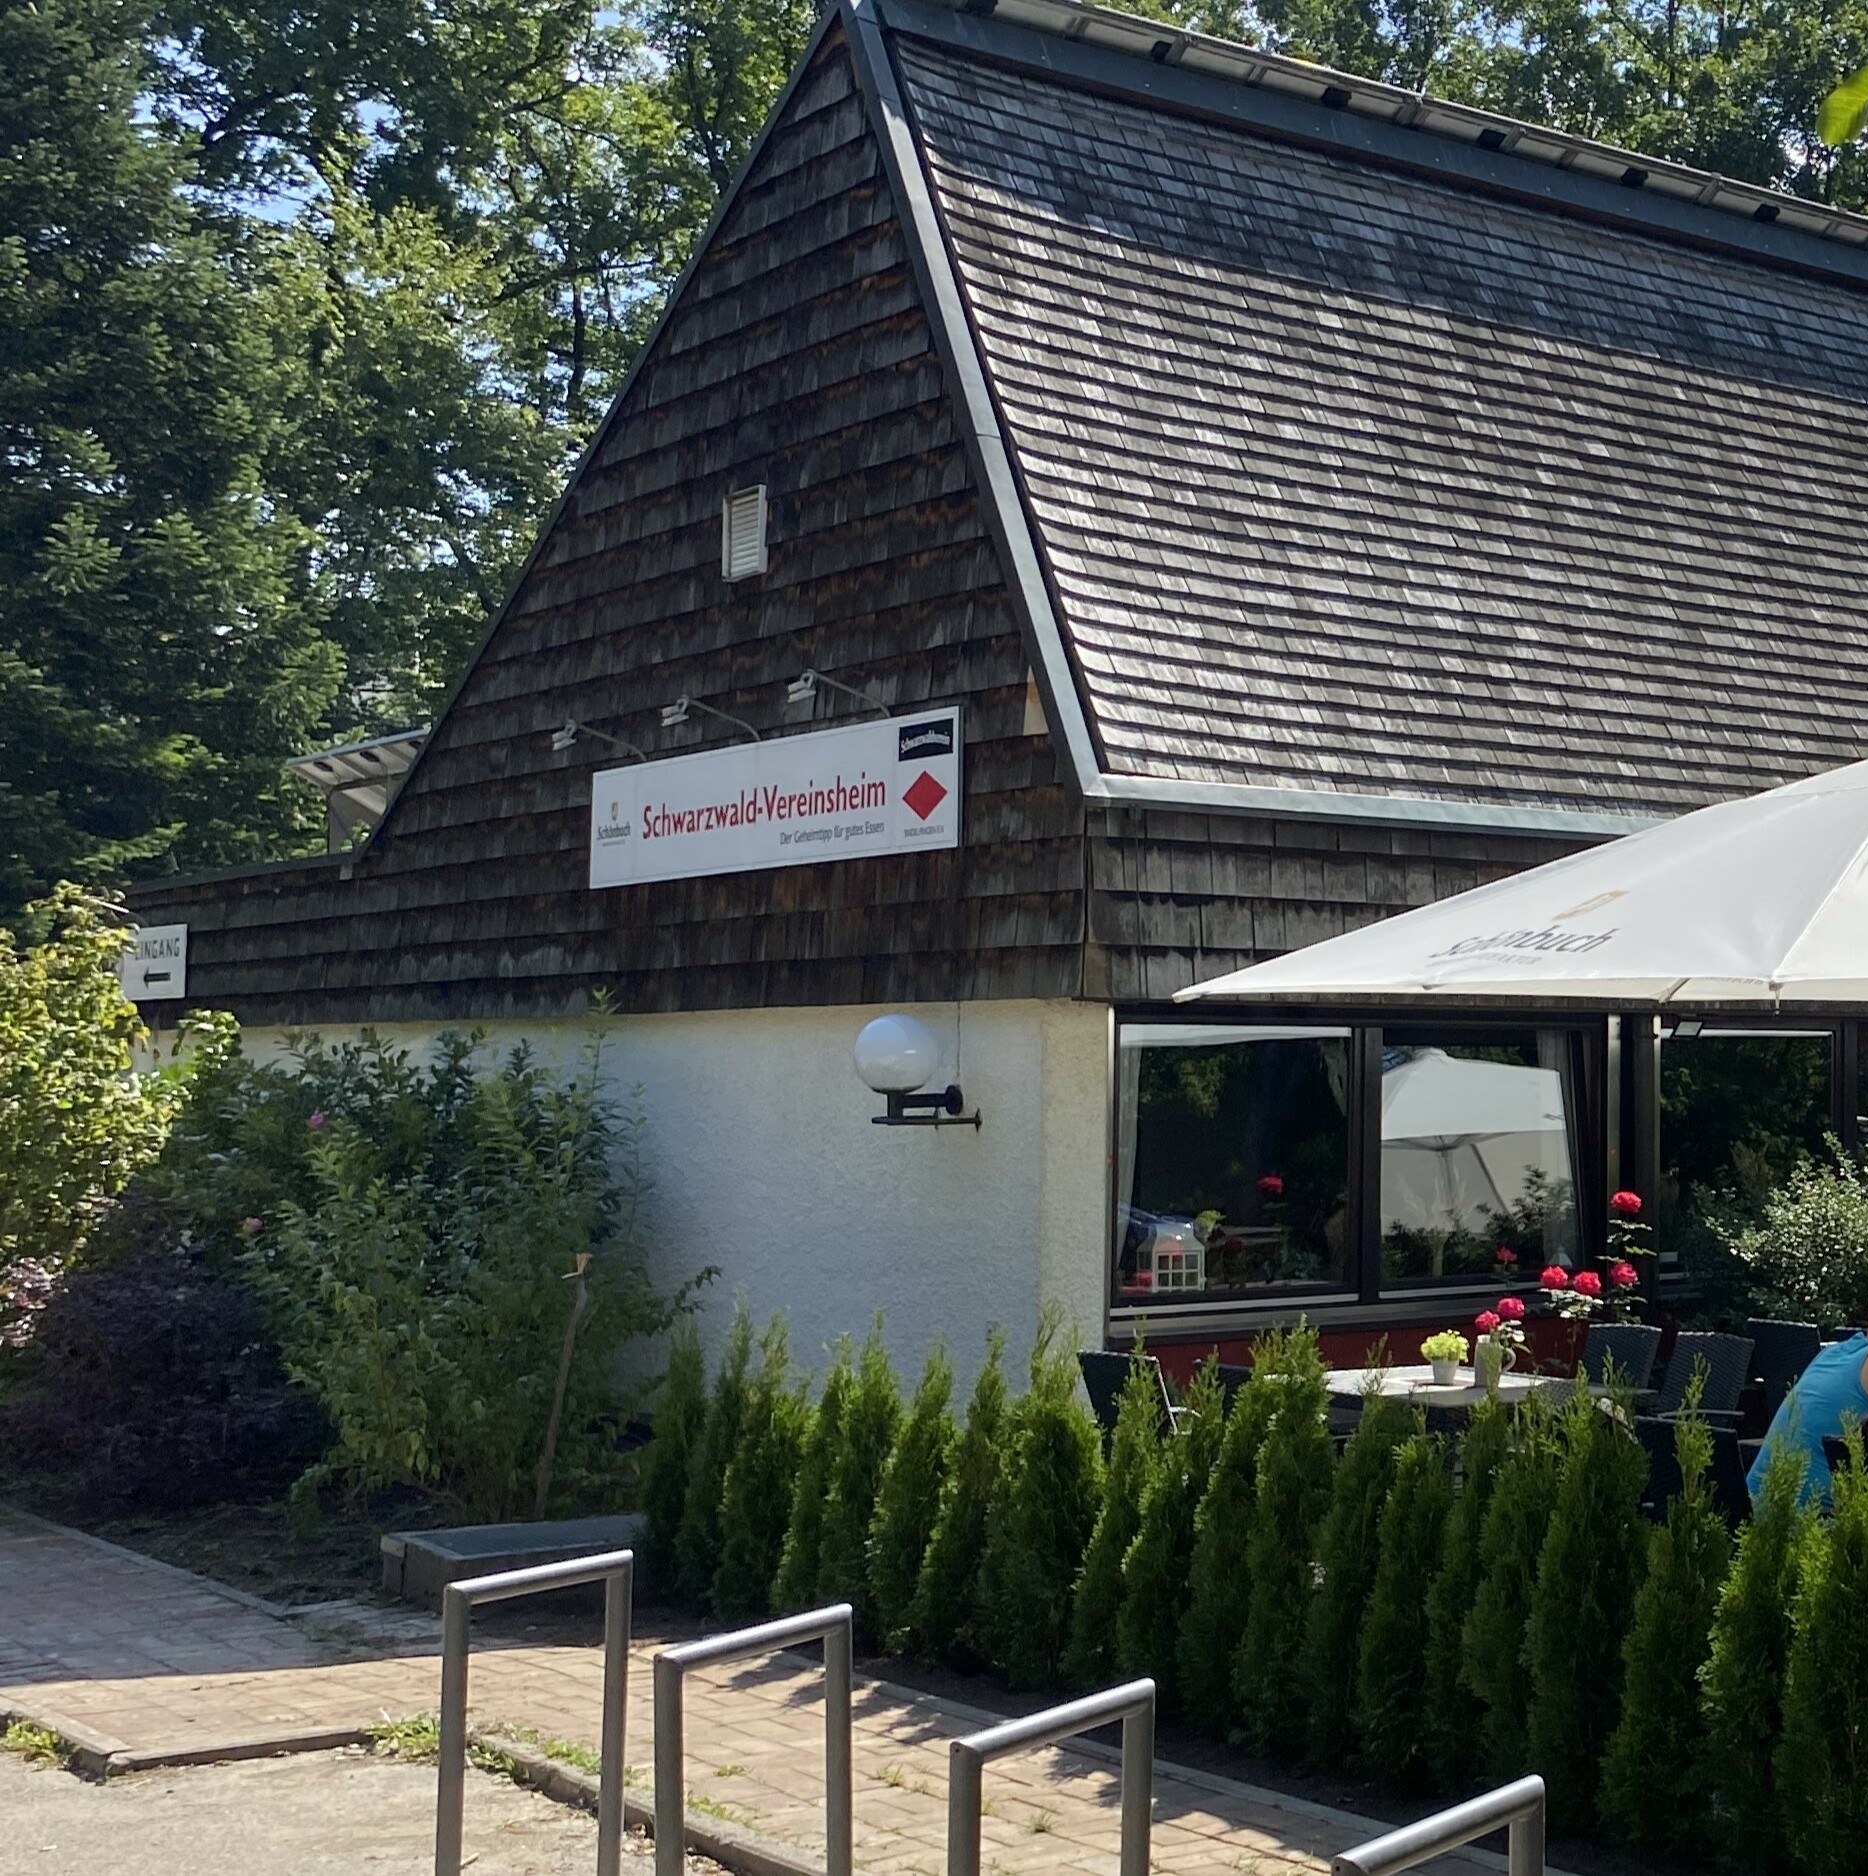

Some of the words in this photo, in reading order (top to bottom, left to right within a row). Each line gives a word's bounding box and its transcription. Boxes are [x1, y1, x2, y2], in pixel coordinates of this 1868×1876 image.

[642, 771, 887, 839] Schwarzwald-Vereinsheim
[779, 831, 793, 845] Der
[865, 821, 885, 835] Essen
